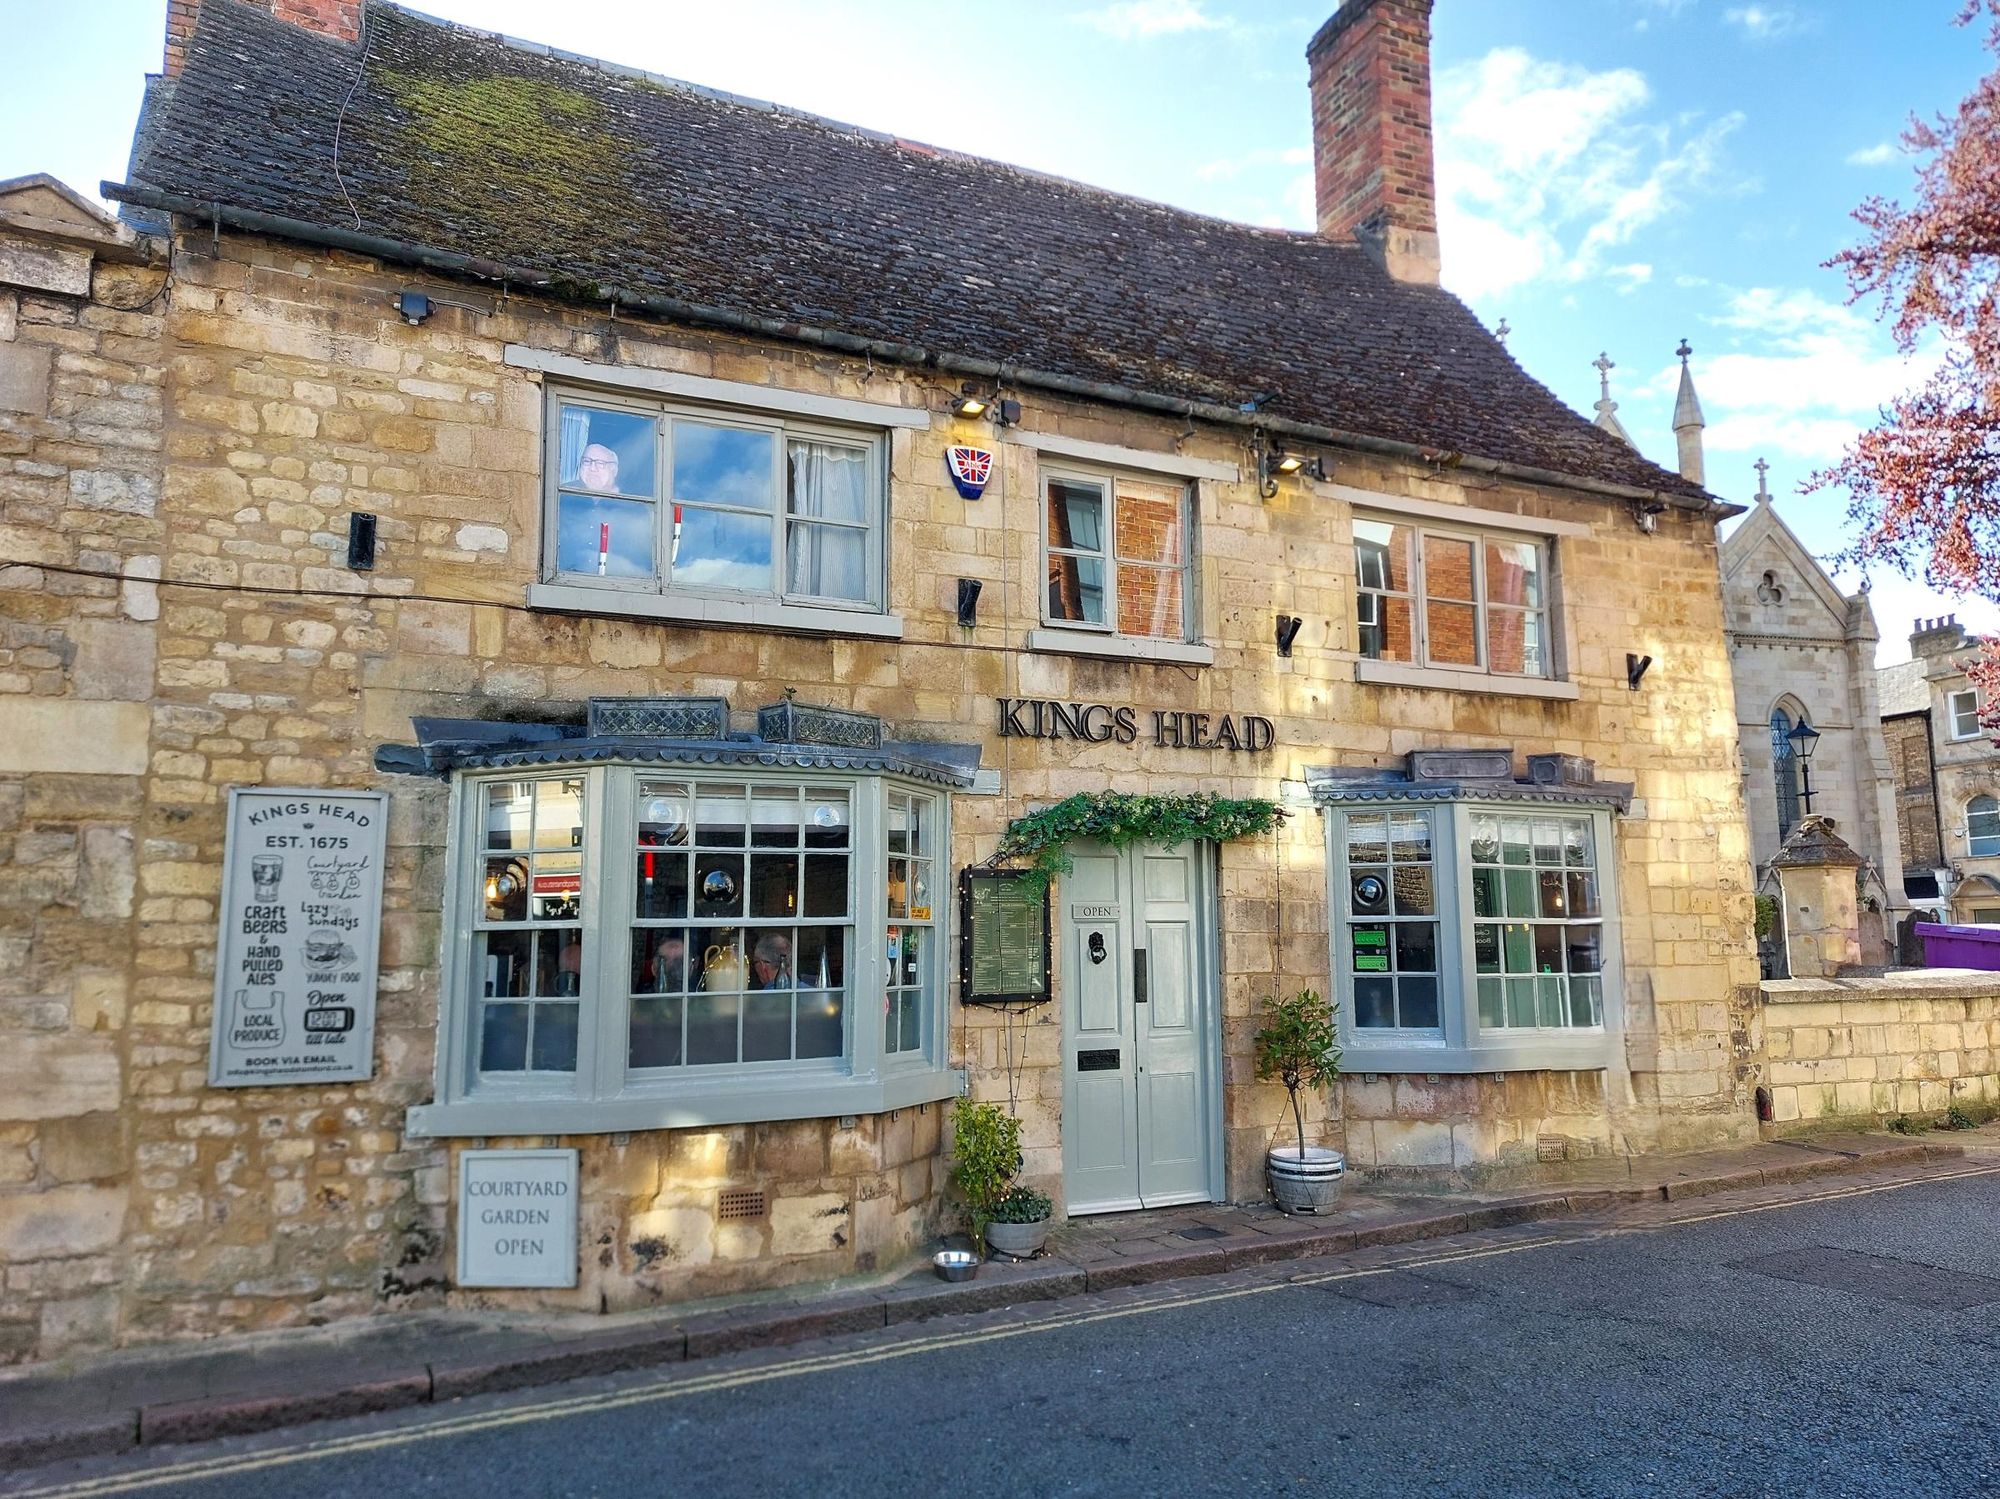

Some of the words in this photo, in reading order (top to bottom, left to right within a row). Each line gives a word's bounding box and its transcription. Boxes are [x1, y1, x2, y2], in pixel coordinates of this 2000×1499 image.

[996, 697, 1138, 744] KINGS
[1152, 710, 1276, 752] HEAD
[248, 803, 310, 826] KINGS
[319, 804, 370, 827] HEAD
[265, 836, 304, 848] EST.
[310, 837, 348, 849] 1675
[301, 901, 328, 917] Lazy
[1083, 907, 1111, 917] OPEN
[308, 916, 360, 931] Sundays
[259, 934, 268, 944] &
[307, 990, 347, 1008] Open
[244, 1015, 274, 1027] LOCAL
[234, 1029, 281, 1042] PRODUCE
[246, 1058, 278, 1066] BOOK
[303, 1055, 337, 1063] EMAIL
[468, 1181, 568, 1196] COURTYARD
[481, 1209, 550, 1224] GARDEN
[495, 1238, 544, 1256] OPEN
